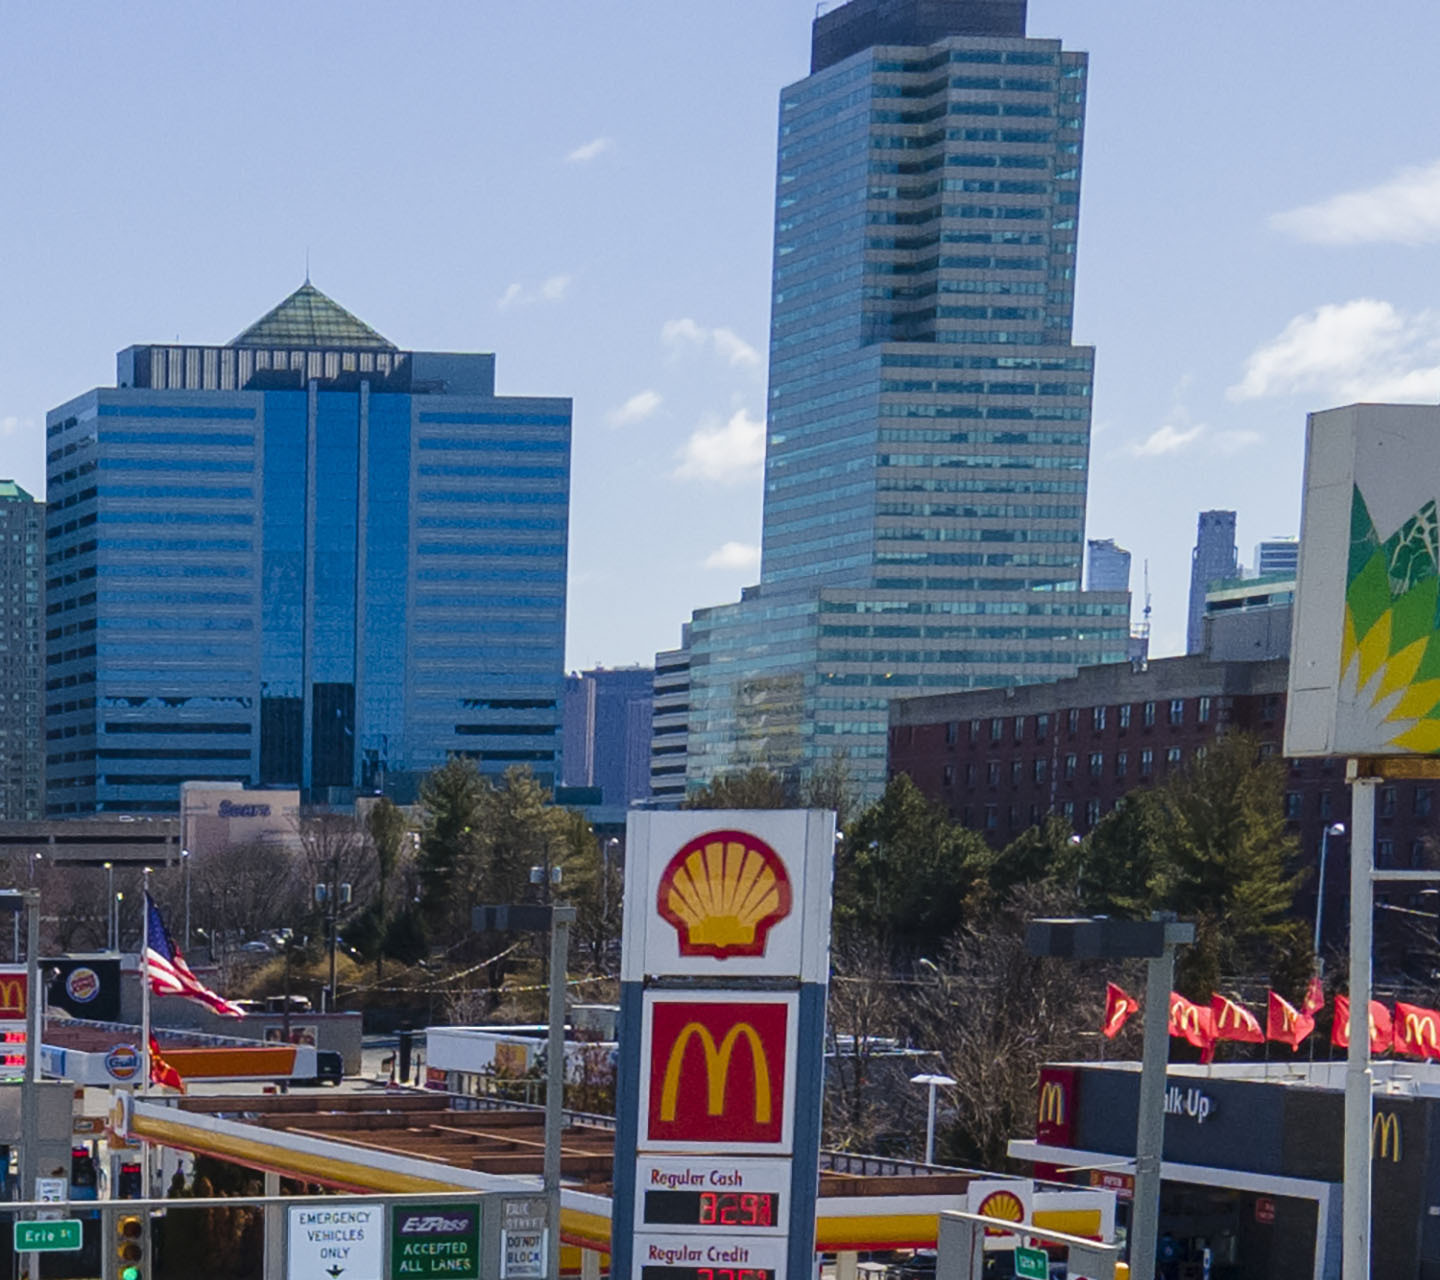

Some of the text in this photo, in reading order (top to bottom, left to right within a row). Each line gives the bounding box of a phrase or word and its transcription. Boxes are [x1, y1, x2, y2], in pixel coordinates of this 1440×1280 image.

[110, 1055, 137, 1067] Gulf
[1187, 1088, 1210, 1124] Up
[650, 1169, 743, 1187] Regular Cash
[299, 1212, 371, 1225] EMERGENCY
[25, 1229, 56, 1242] Erie
[307, 1229, 365, 1242] VEHICLES
[320, 1247, 350, 1259] ONLY
[403, 1242, 468, 1256] ACCEPTED
[648, 1245, 749, 1264] Regular Credit
[507, 1251, 539, 1264] BLOCK
[399, 1259, 471, 1273] ALL LANES
